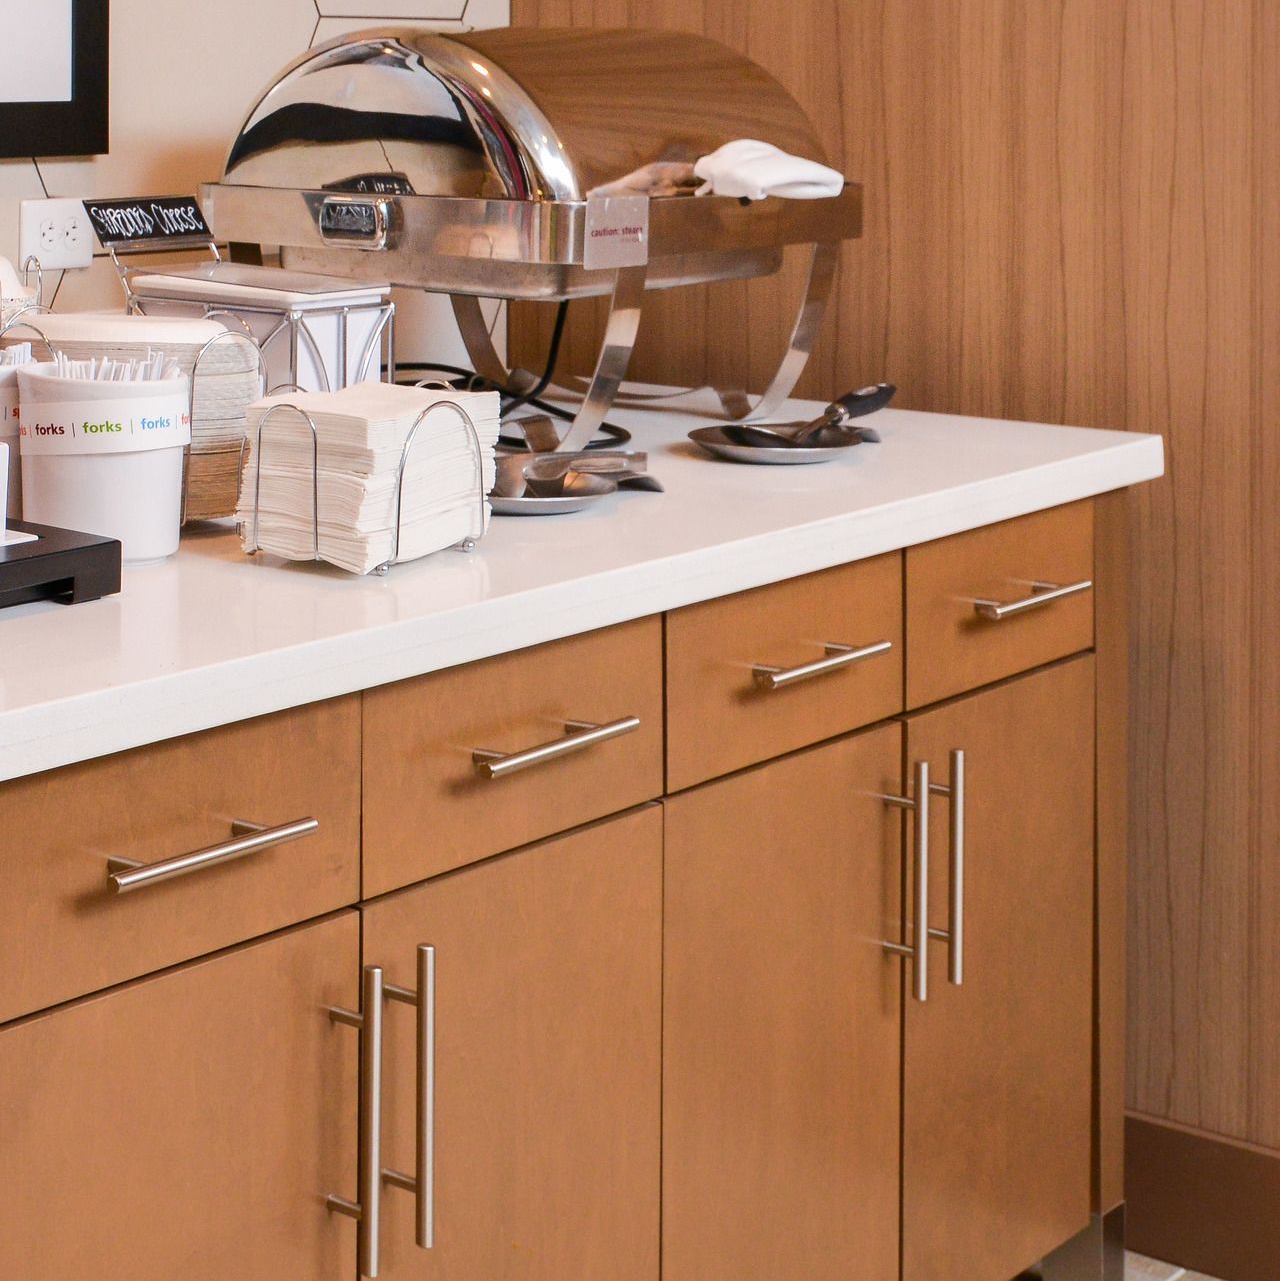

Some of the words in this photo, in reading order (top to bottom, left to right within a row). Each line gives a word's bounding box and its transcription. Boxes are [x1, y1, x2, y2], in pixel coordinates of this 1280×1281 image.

[35, 423, 65, 436] forks
[82, 421, 123, 434] forks
[140, 417, 171, 431] forks
